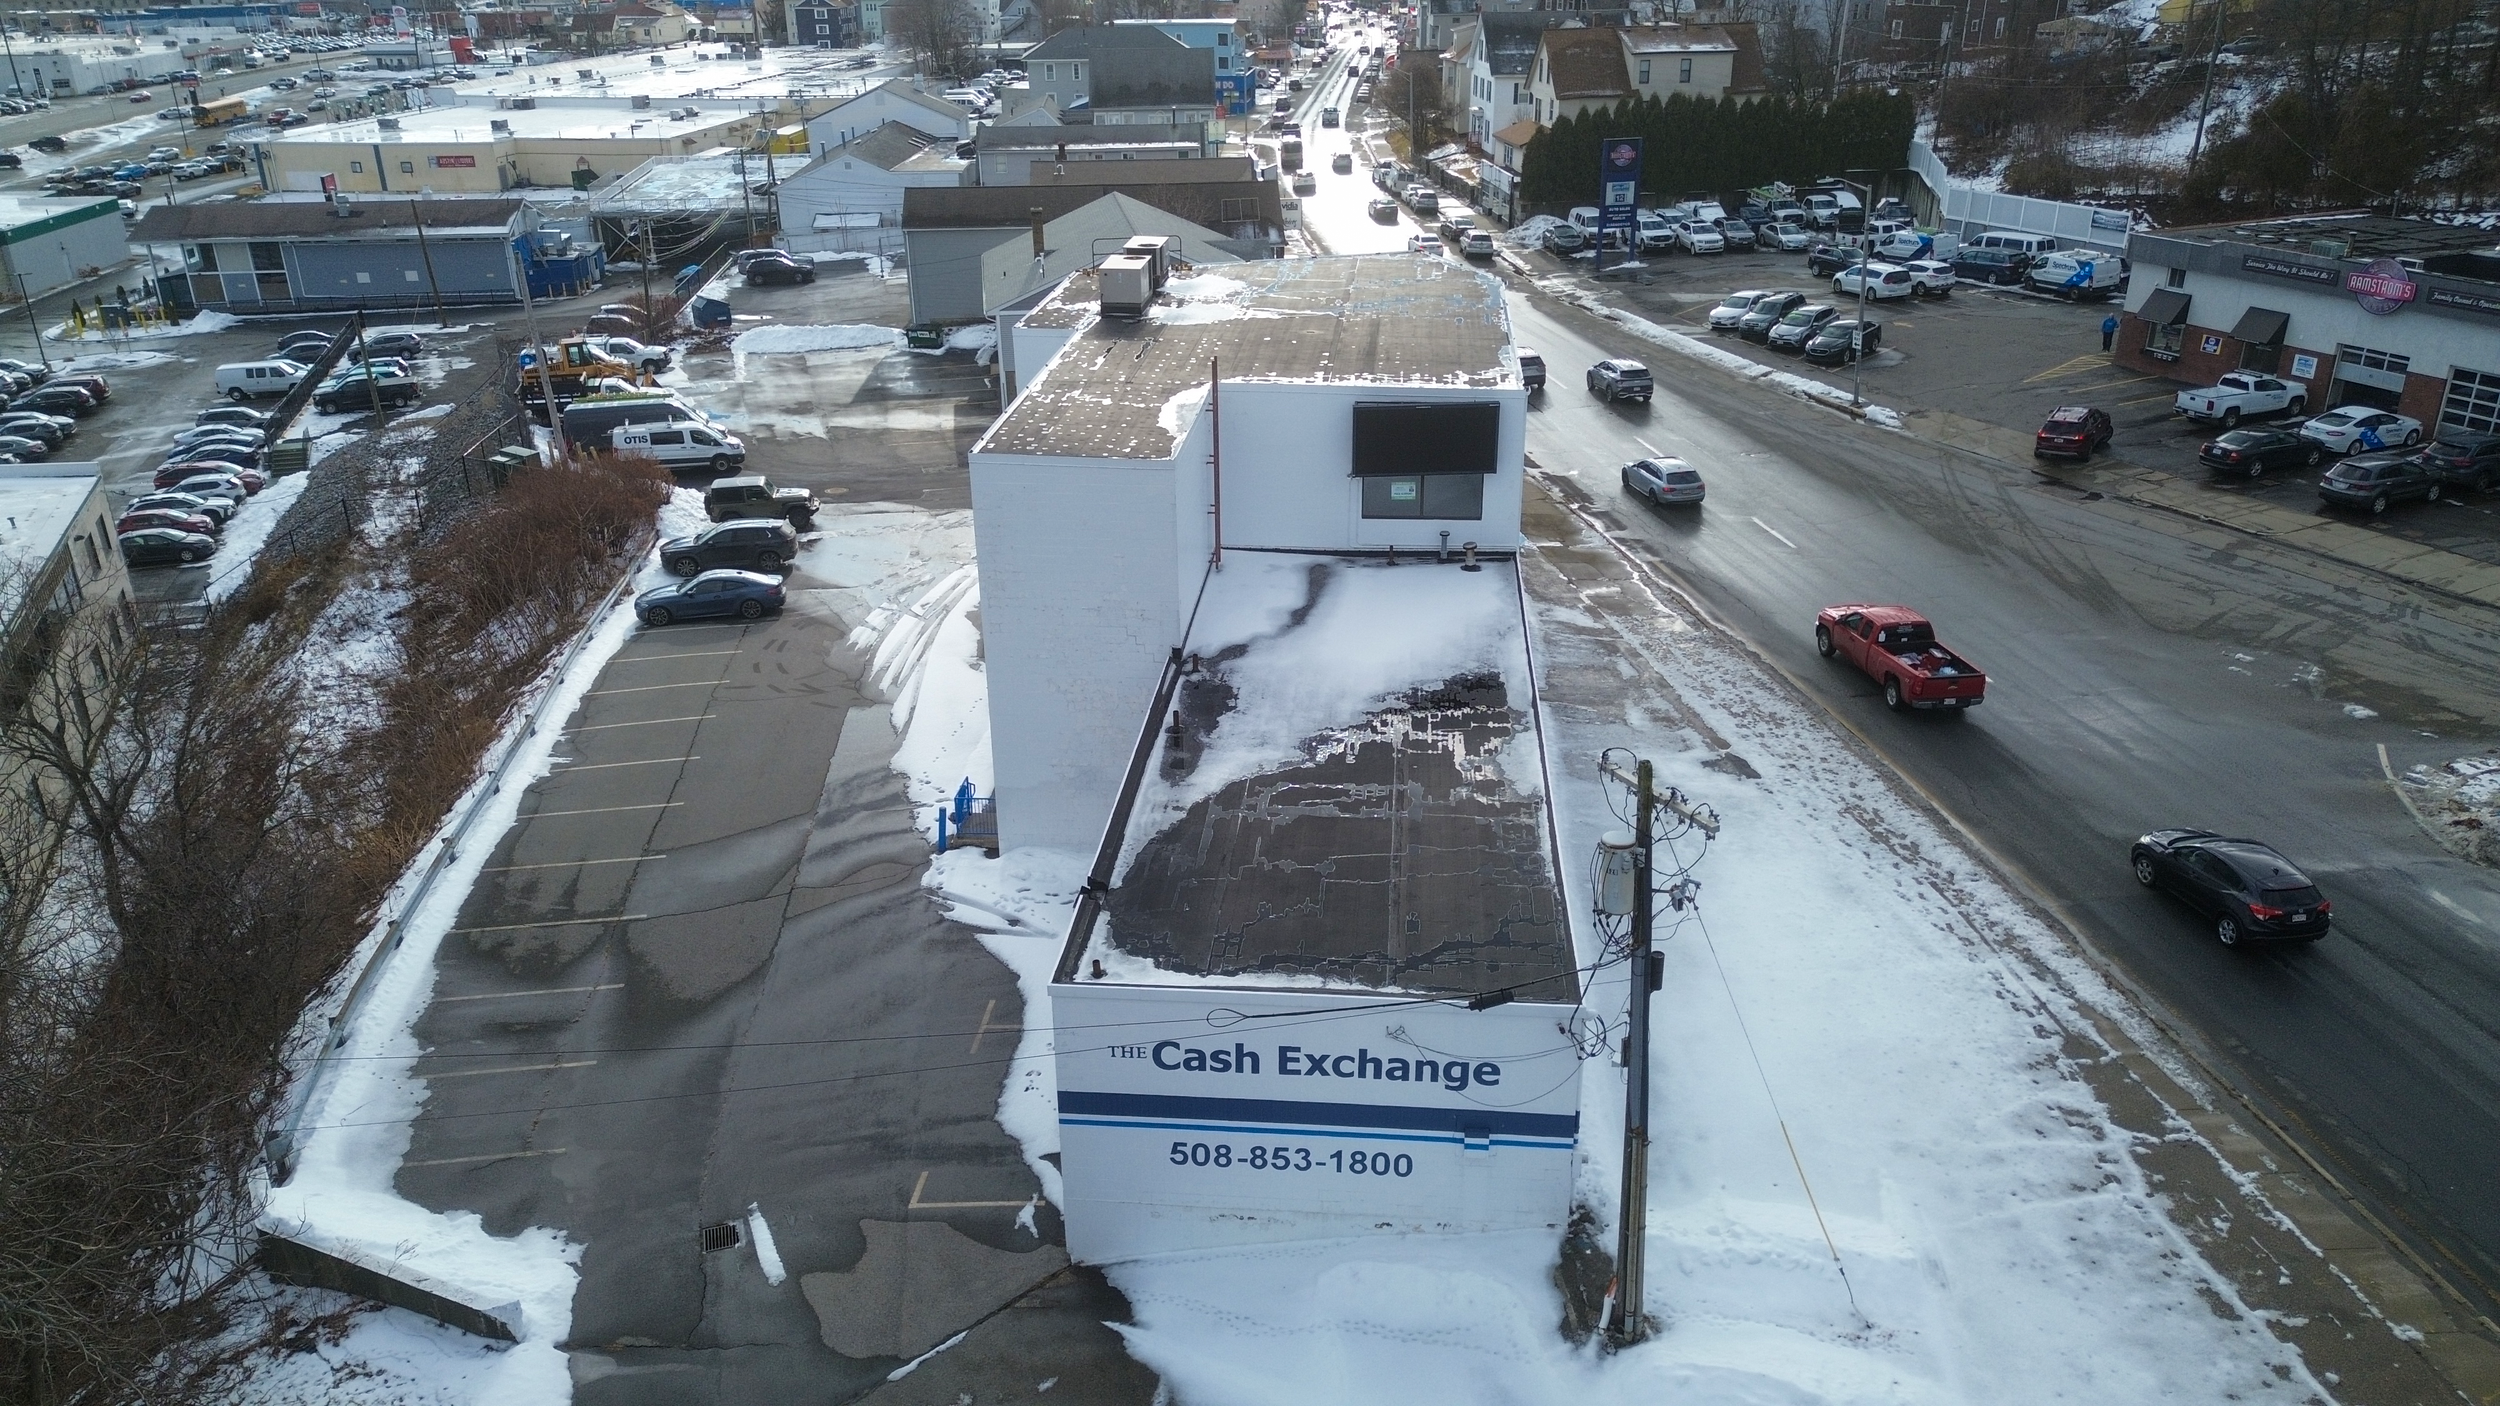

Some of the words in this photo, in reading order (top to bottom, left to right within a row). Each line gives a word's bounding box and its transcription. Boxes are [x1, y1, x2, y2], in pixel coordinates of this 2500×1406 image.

[1897, 237, 1920, 247] Spectrum
[2052, 260, 2078, 273] Spectrum
[2246, 259, 2265, 267] Service
[2276, 264, 2290, 274] Way
[2298, 268, 2320, 278] Should
[2431, 292, 2453, 303] Family
[2453, 296, 2472, 306] Owned
[623, 435, 649, 445] OTIS
[1107, 1045, 1148, 1059] THE
[1152, 1040, 1261, 1075] Cash
[1278, 1045, 1502, 1092] Exchange
[1169, 1141, 1414, 1178] 508-853-1800
